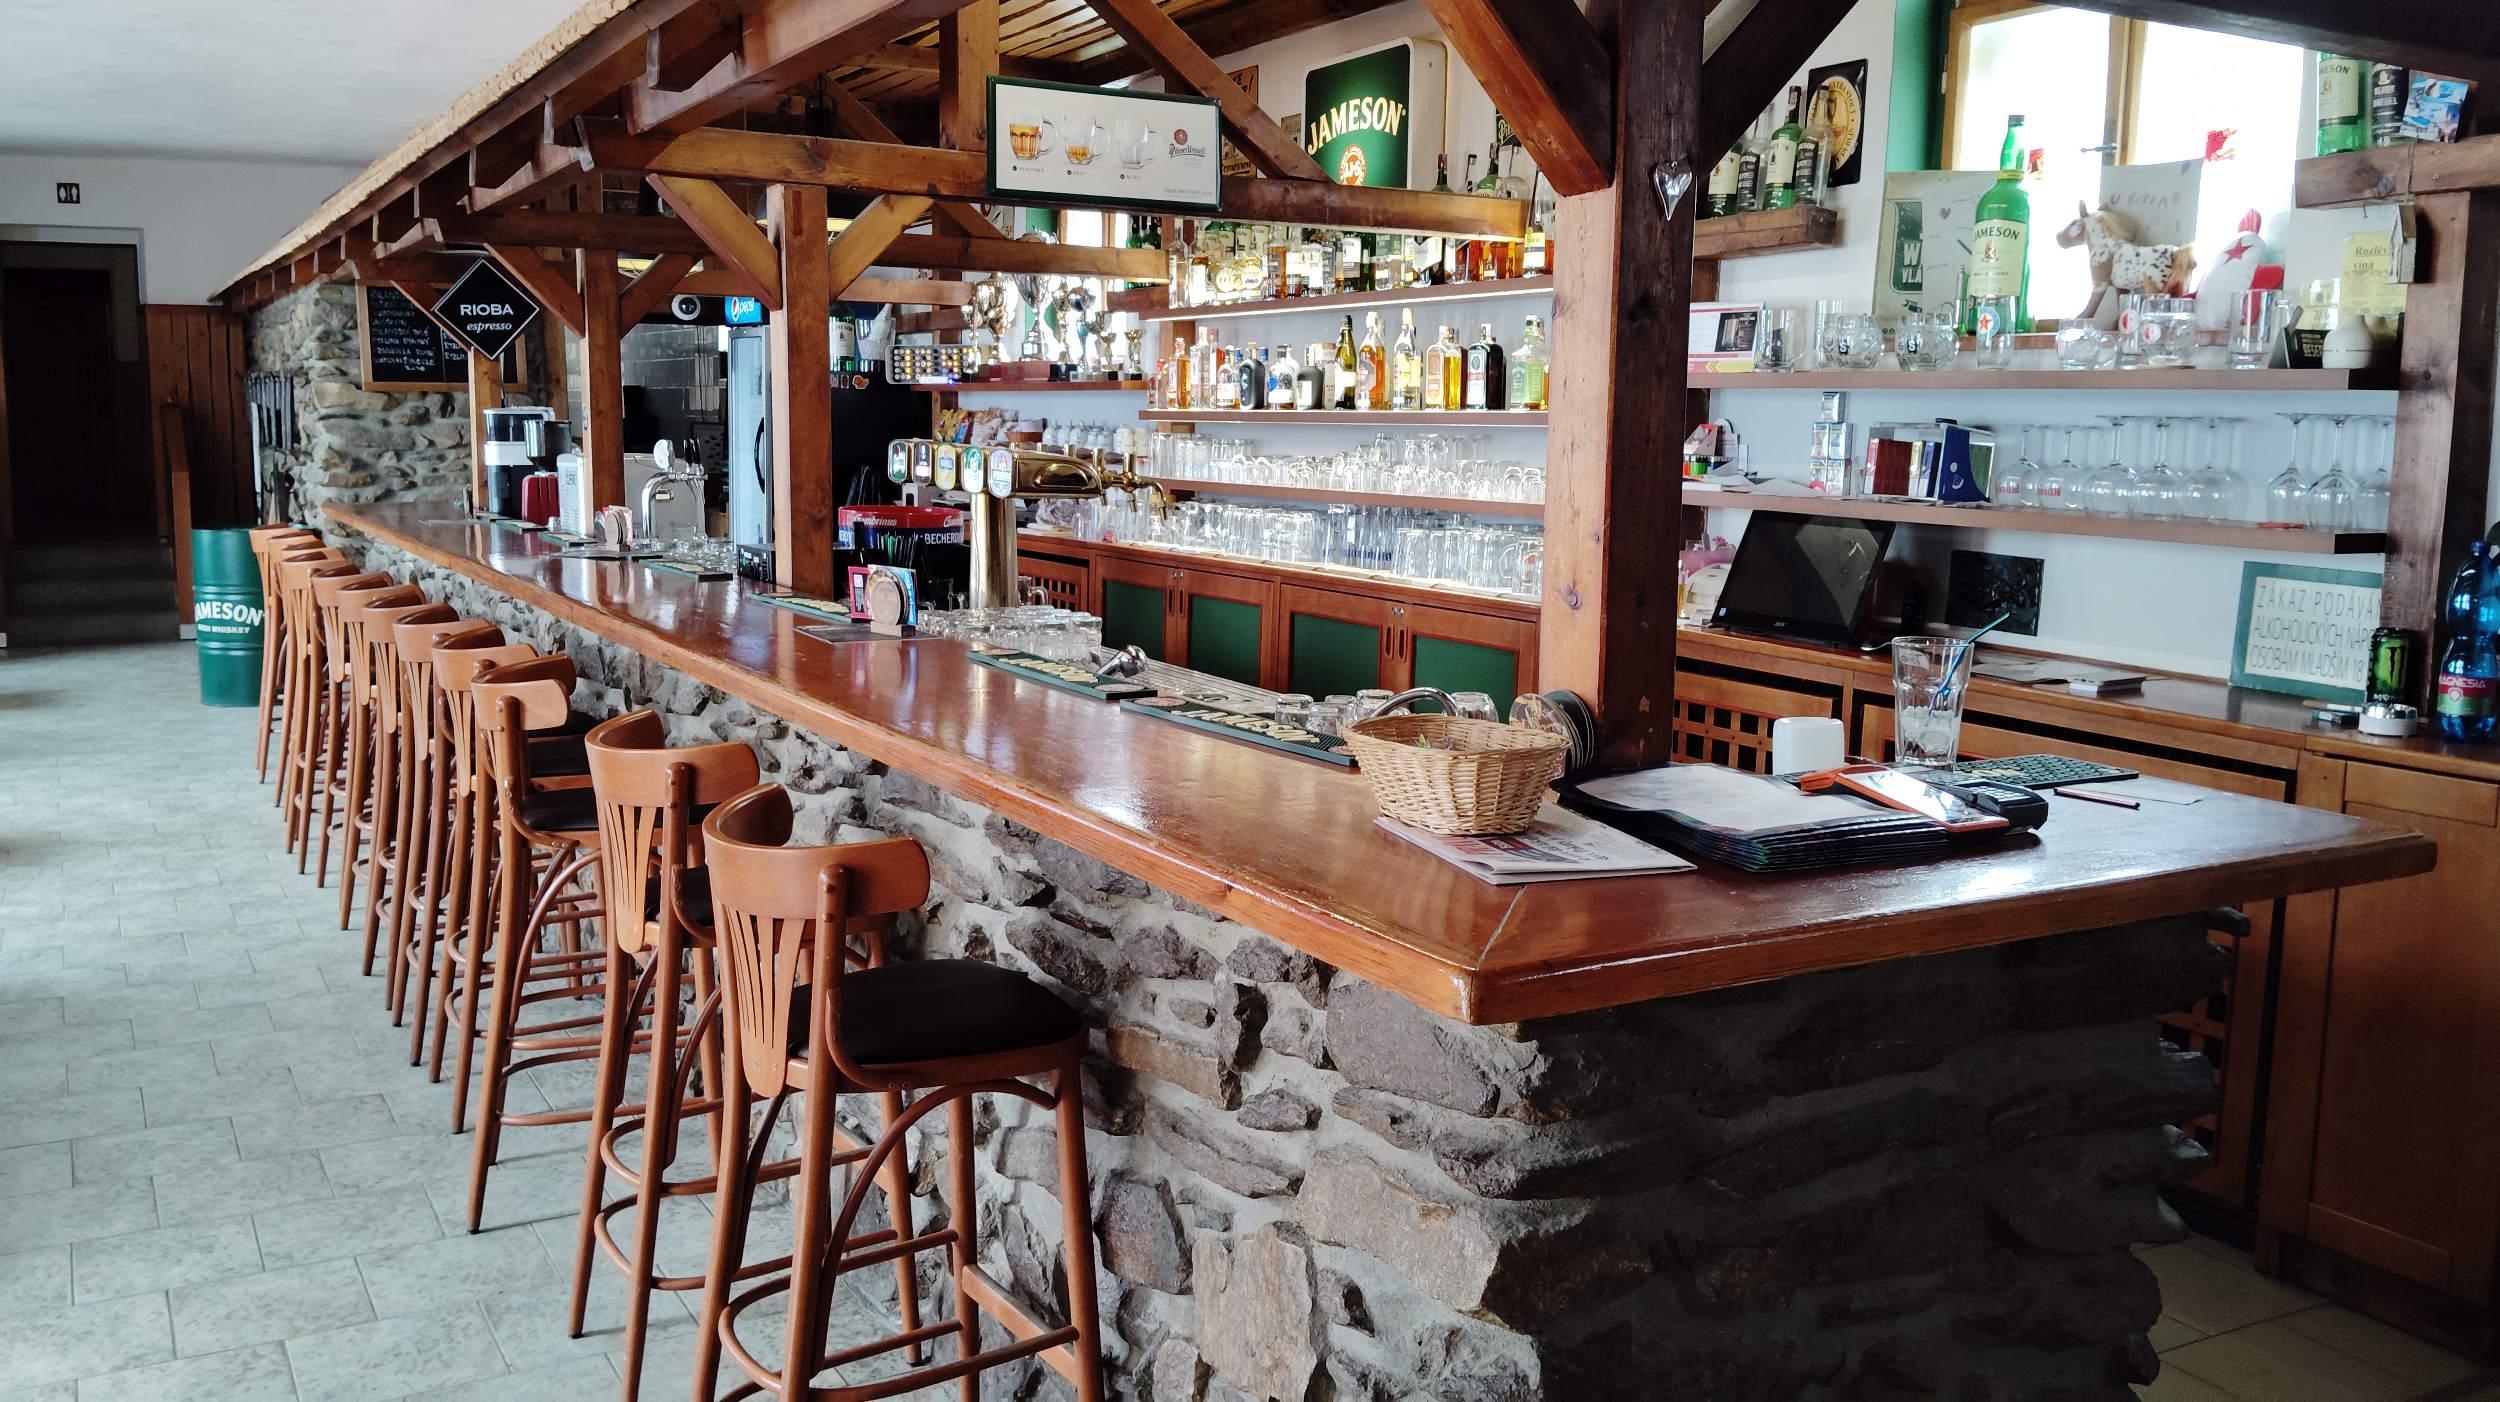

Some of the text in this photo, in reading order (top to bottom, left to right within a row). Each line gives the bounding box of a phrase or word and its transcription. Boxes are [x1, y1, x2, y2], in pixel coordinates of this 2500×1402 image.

[1307, 96, 1403, 155] JAMESON
[460, 304, 514, 316] RIOBA
[466, 321, 513, 334] espresso
[2257, 580, 2307, 613] ZÁKAZ
[195, 601, 263, 627] AMESON
